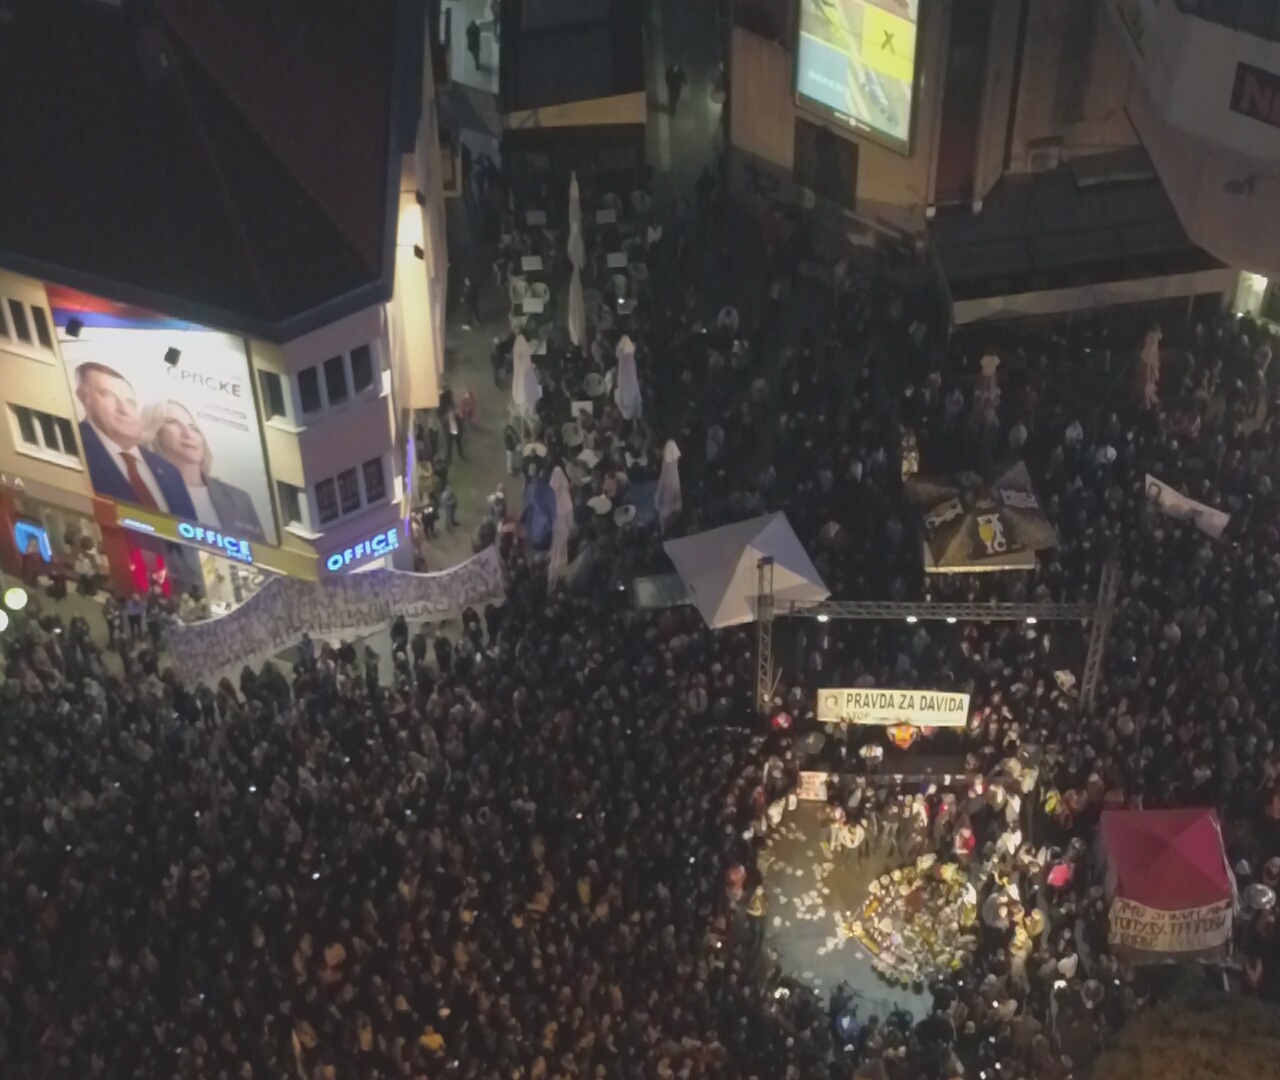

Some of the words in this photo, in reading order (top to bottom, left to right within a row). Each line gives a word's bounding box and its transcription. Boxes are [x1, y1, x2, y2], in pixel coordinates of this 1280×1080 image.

[178, 523, 250, 556] OFFICE
[327, 528, 397, 571] OFFICE
[846, 693, 895, 709] PRAVDA
[899, 694, 915, 710] ZA
[920, 695, 964, 712] DAVIDA
